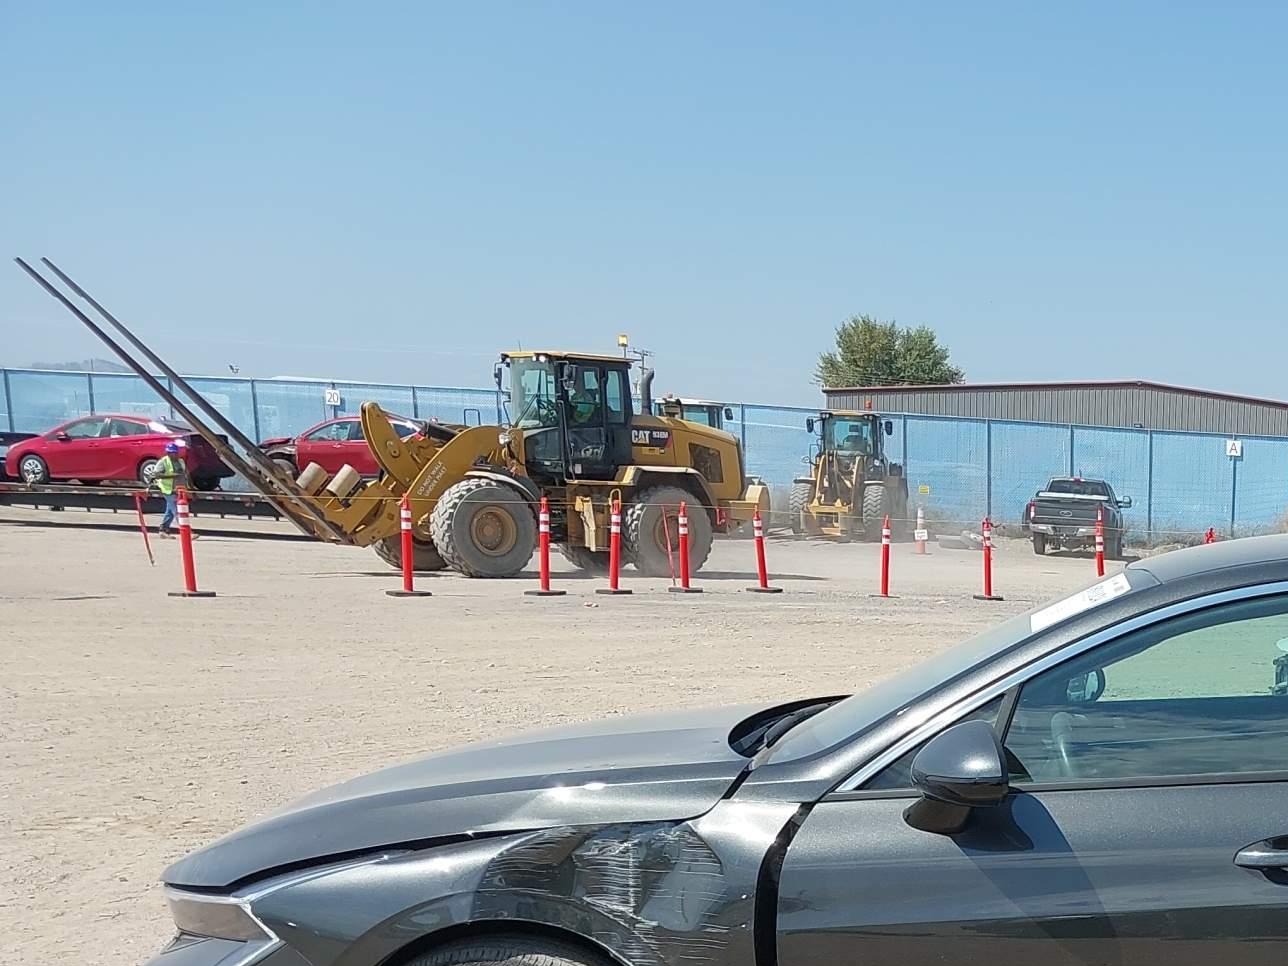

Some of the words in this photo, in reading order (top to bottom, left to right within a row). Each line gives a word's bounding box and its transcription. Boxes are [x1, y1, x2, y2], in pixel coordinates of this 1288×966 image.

[327, 391, 339, 403] 20
[631, 429, 650, 444] CAT
[1229, 442, 1238, 454] A
[430, 460, 444, 475] WALK
